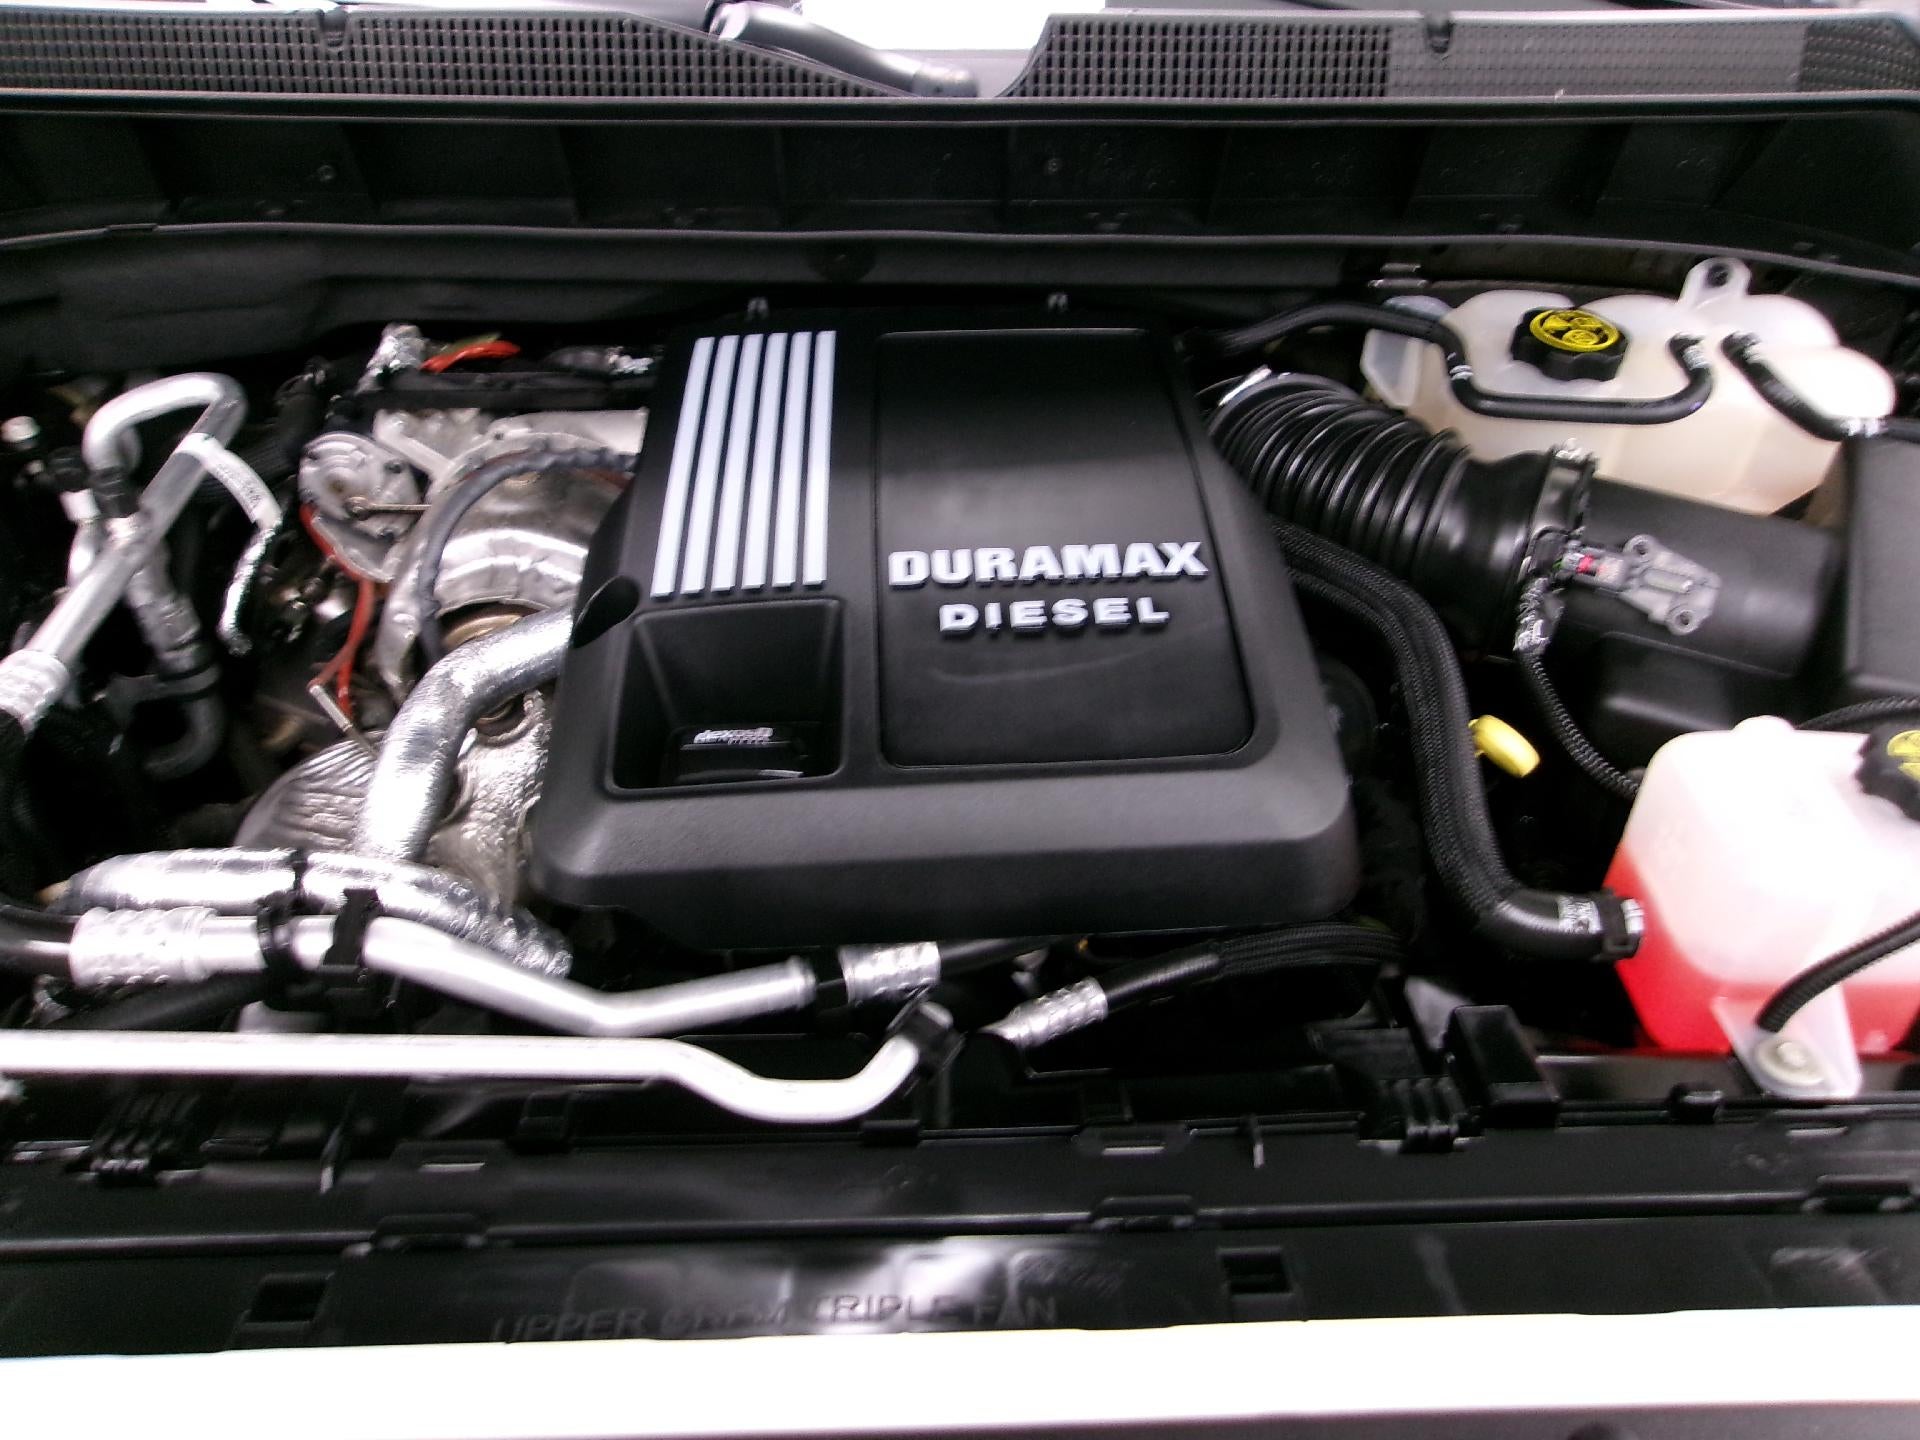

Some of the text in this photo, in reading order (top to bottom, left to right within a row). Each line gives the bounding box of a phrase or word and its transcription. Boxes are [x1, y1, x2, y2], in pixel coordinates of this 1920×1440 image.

[888, 541, 1209, 587] DURAMAX
[939, 597, 1170, 633] DIESEL
[488, 1308, 648, 1342] UPPER
[814, 1294, 963, 1323] TRIPLE
[973, 1296, 1057, 1327] FAN
